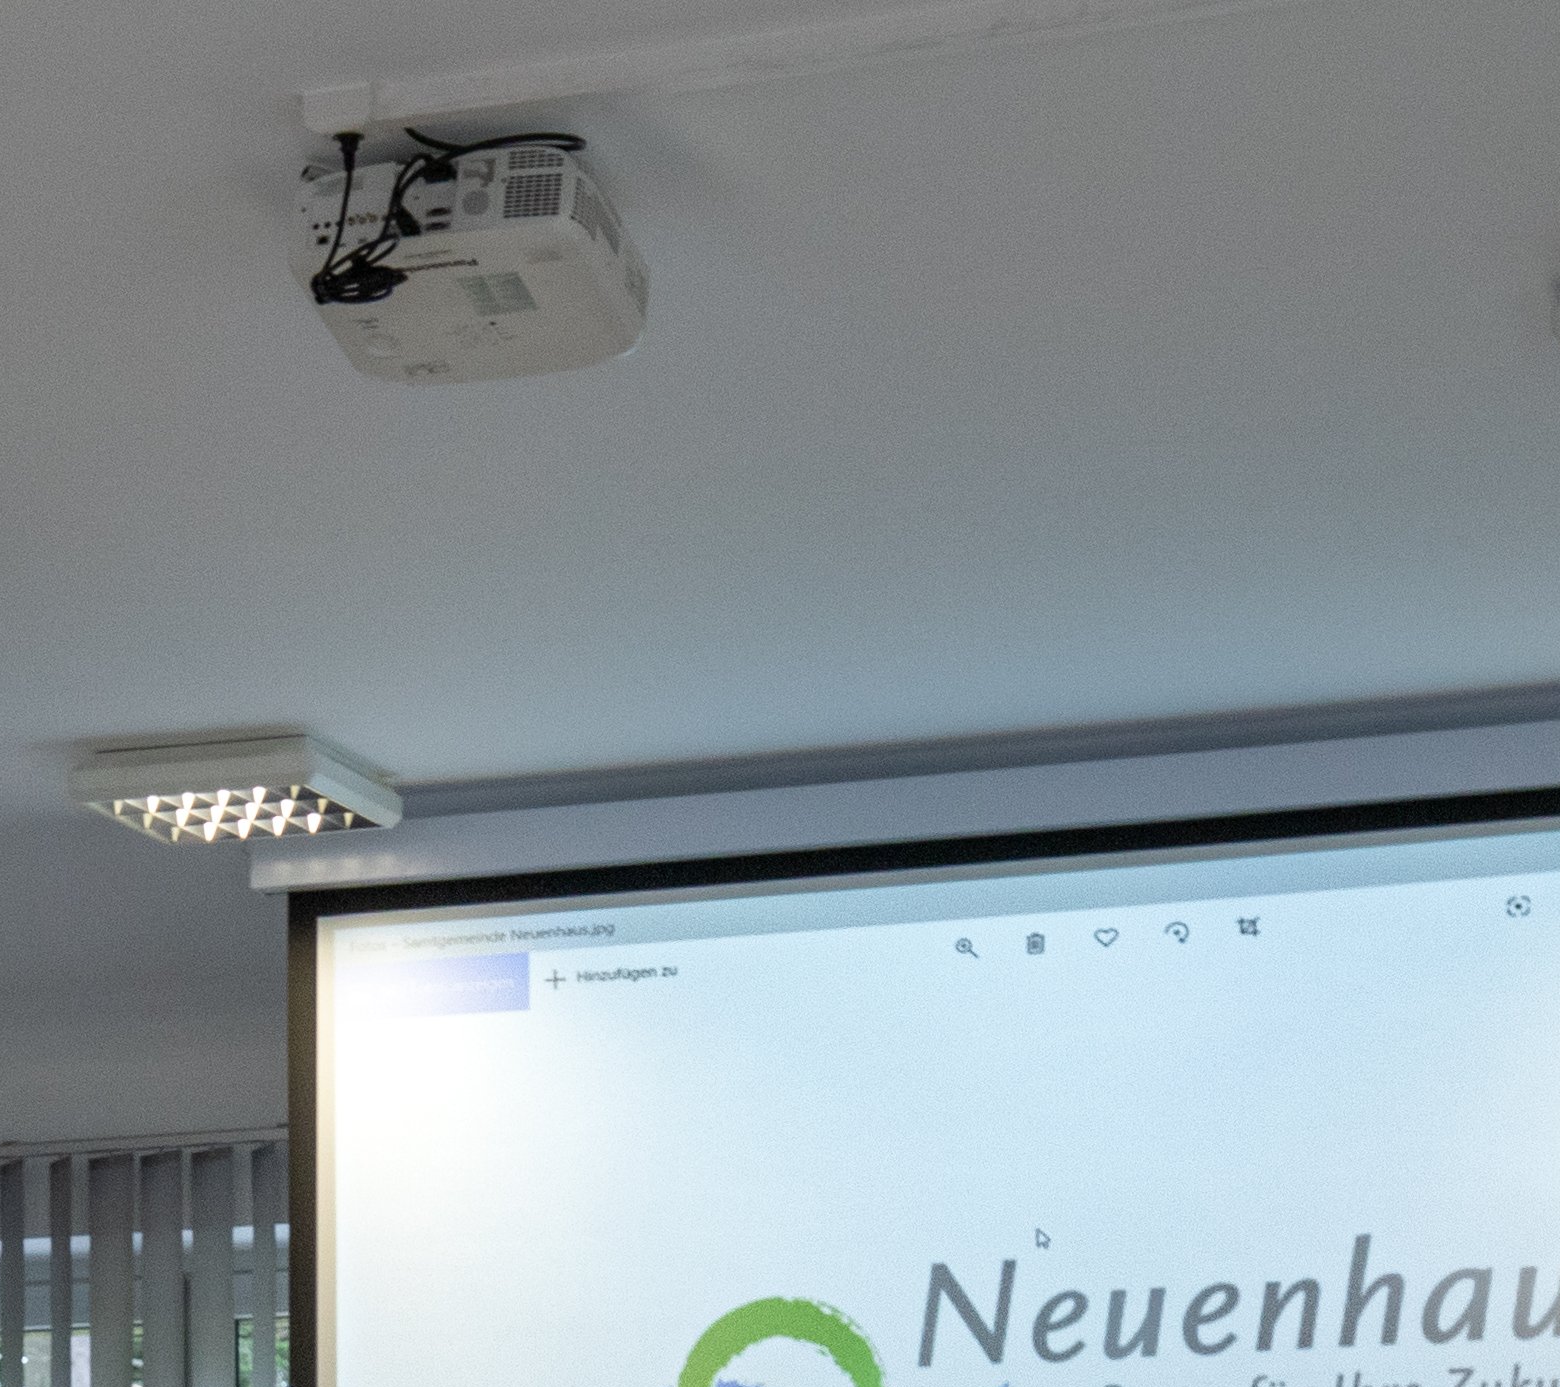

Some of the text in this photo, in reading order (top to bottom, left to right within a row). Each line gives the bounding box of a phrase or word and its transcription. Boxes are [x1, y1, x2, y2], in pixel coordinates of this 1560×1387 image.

[510, 920, 616, 943] Neuenhaus.jpg
[576, 964, 679, 985] Hinzufügen zu
